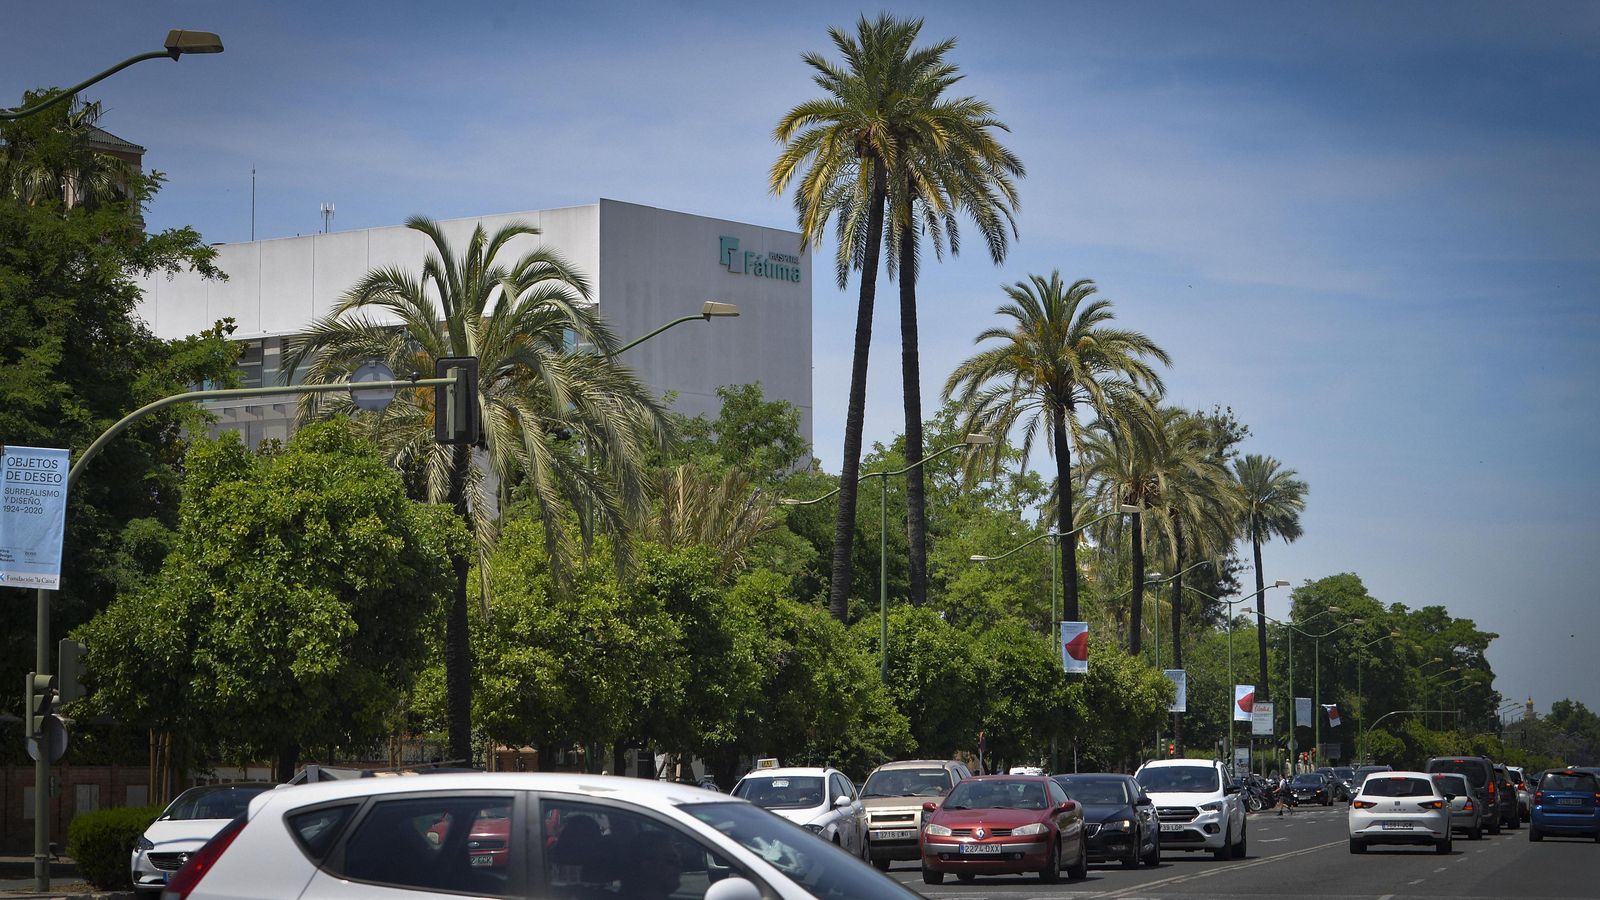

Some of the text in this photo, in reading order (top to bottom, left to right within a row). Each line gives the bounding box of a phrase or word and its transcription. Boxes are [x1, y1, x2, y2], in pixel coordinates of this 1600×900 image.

[744, 250, 801, 283] Fátima
[7, 456, 59, 469] OBJETOS
[6, 470, 63, 483] DE DESEO
[4, 487, 60, 498] SURREALISMO
[4, 495, 42, 506] Y DISEÑO,
[6, 574, 35, 583] Fundación
[964, 844, 1000, 853] 2274 DXX
